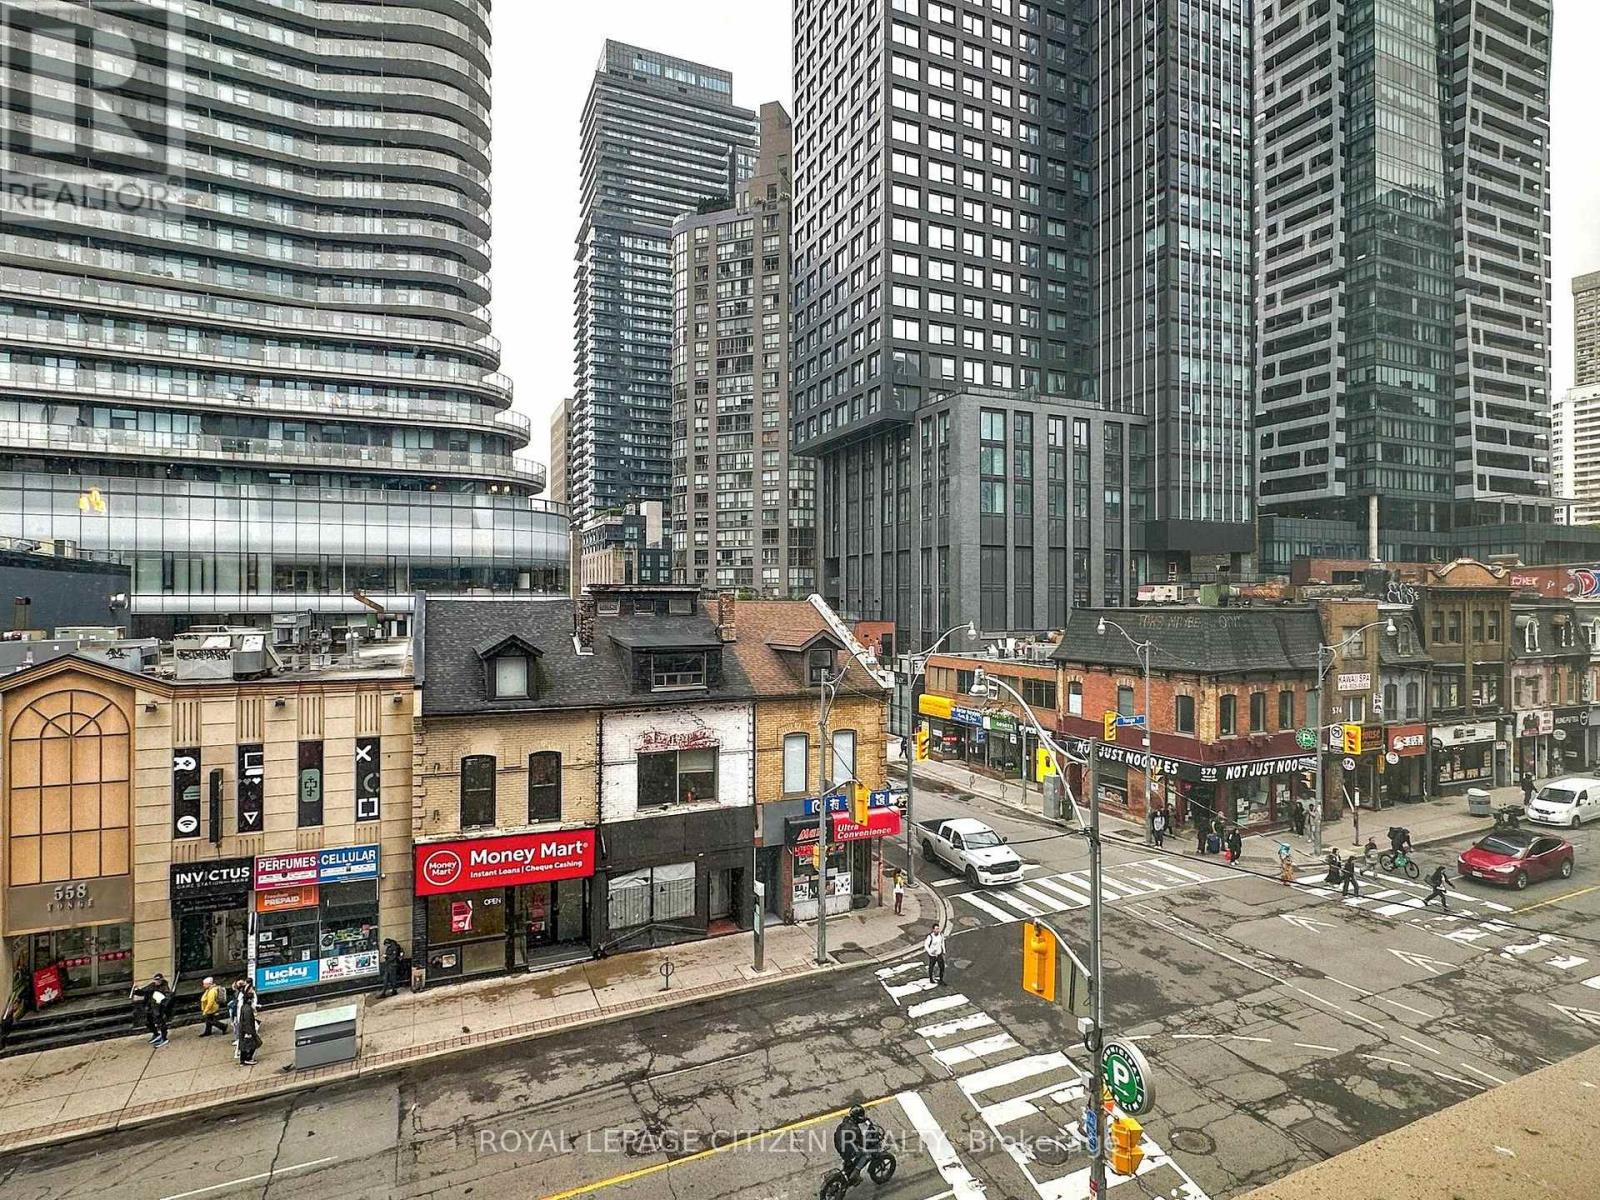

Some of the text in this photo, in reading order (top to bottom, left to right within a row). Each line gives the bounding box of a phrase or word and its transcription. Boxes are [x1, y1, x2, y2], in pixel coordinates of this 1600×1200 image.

[1098, 746, 1124, 762] JUST
[1201, 767, 1217, 776] 570
[1225, 764, 1248, 781] NOT
[1249, 761, 1275, 778] JUST
[837, 822, 859, 833] Ultra
[837, 828, 892, 841] Convenience
[258, 856, 317, 872] PERFUMES
[320, 849, 376, 866] CELLULAR
[470, 841, 583, 866] Money Mart
[175, 867, 250, 885] INVICTUS
[432, 868, 453, 876] Mart
[470, 870, 497, 878] Instant
[498, 867, 521, 875] Loans
[525, 864, 553, 873] Cheque
[554, 860, 583, 869] Cashing
[54, 883, 88, 901] 558
[47, 899, 94, 912] YONGE
[264, 896, 300, 907] PREPAID
[484, 897, 502, 906] OPEN
[265, 967, 308, 980] lucky
[1112, 1059, 1130, 1087] P
